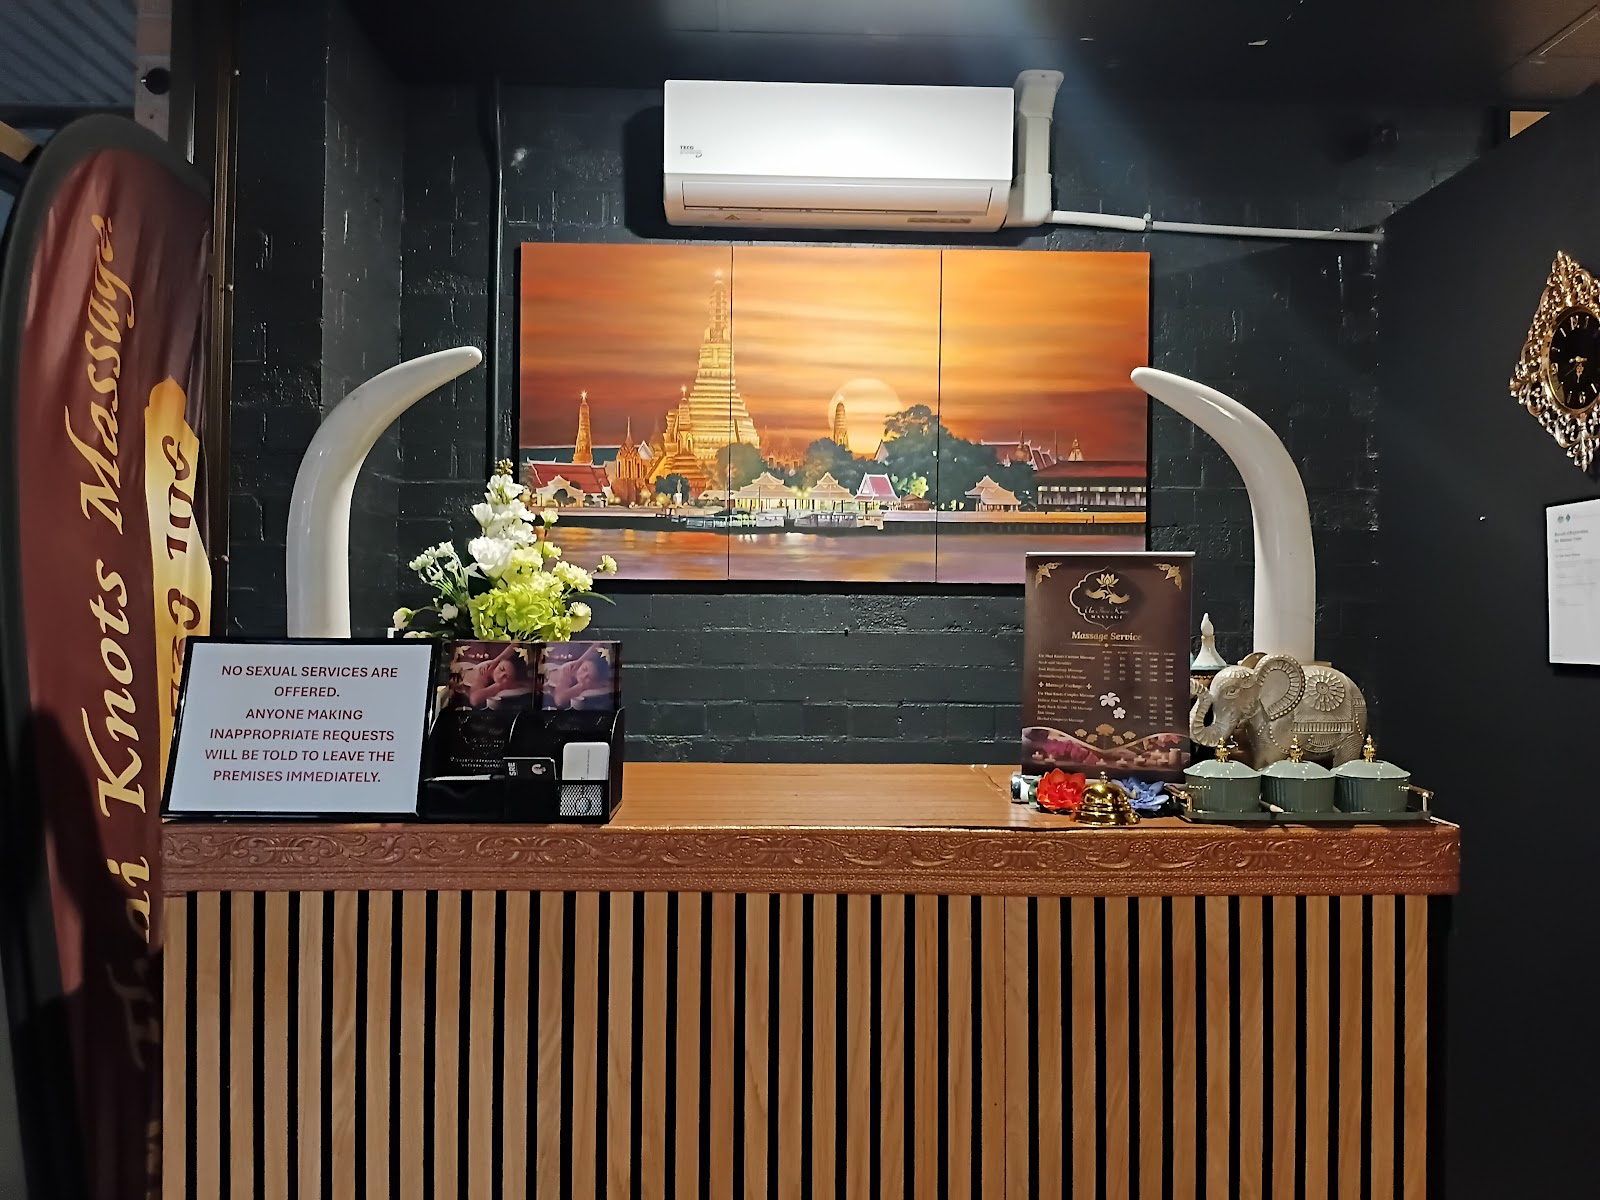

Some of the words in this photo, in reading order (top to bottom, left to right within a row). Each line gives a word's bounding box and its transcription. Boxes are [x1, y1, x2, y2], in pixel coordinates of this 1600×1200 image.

[64, 213, 135, 536] Massage
[1071, 630, 1108, 642] Massage
[1110, 632, 1142, 641] Service
[221, 665, 243, 676] NO
[245, 665, 298, 677] SEXUAL
[301, 666, 368, 678] SERVICES
[370, 667, 398, 678] ARE
[81, 557, 146, 817] Knots
[274, 686, 340, 698] OFFERED.
[245, 708, 304, 720] ANYONE
[307, 709, 364, 721] MAKING
[209, 728, 320, 741] INAPPROPRIATE
[322, 729, 395, 743] REQUESTS
[205, 749, 238, 760] WILL
[241, 749, 259, 761] BE
[262, 750, 298, 761] TOLD
[302, 750, 319, 761] TO
[322, 750, 365, 762] LEAVE
[368, 751, 395, 762] THE
[213, 770, 283, 782] PREMISES
[286, 771, 382, 783] IMMEDIATELY.
